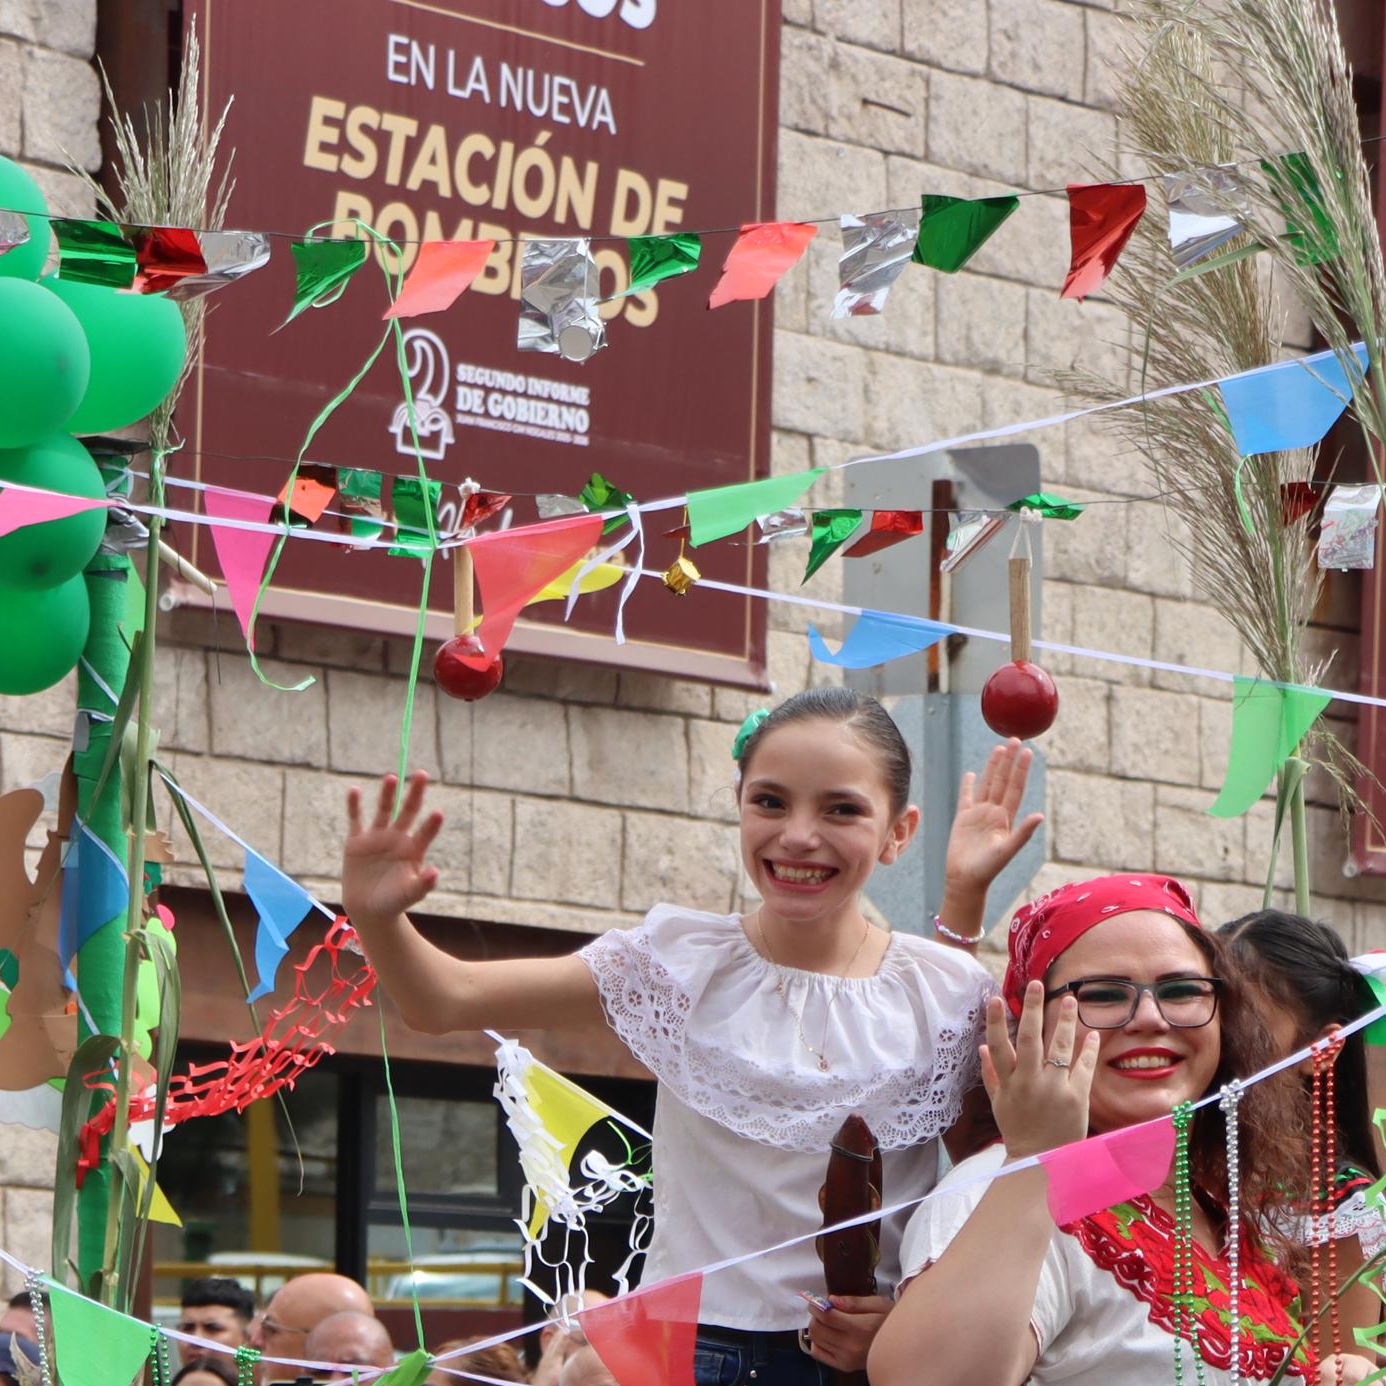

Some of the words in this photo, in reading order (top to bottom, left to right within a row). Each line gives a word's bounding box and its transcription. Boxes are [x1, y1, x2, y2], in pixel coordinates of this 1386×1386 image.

[387, 33, 437, 90] EN
[447, 48, 491, 104] LA
[499, 62, 618, 136] NUEVA
[303, 95, 599, 231] ESTACIÓN
[609, 167, 690, 240] DE
[456, 363, 526, 394] SEGUNDO
[527, 375, 591, 406] INFORME
[456, 385, 486, 414] DE
[487, 391, 591, 434] GOBIERNO
